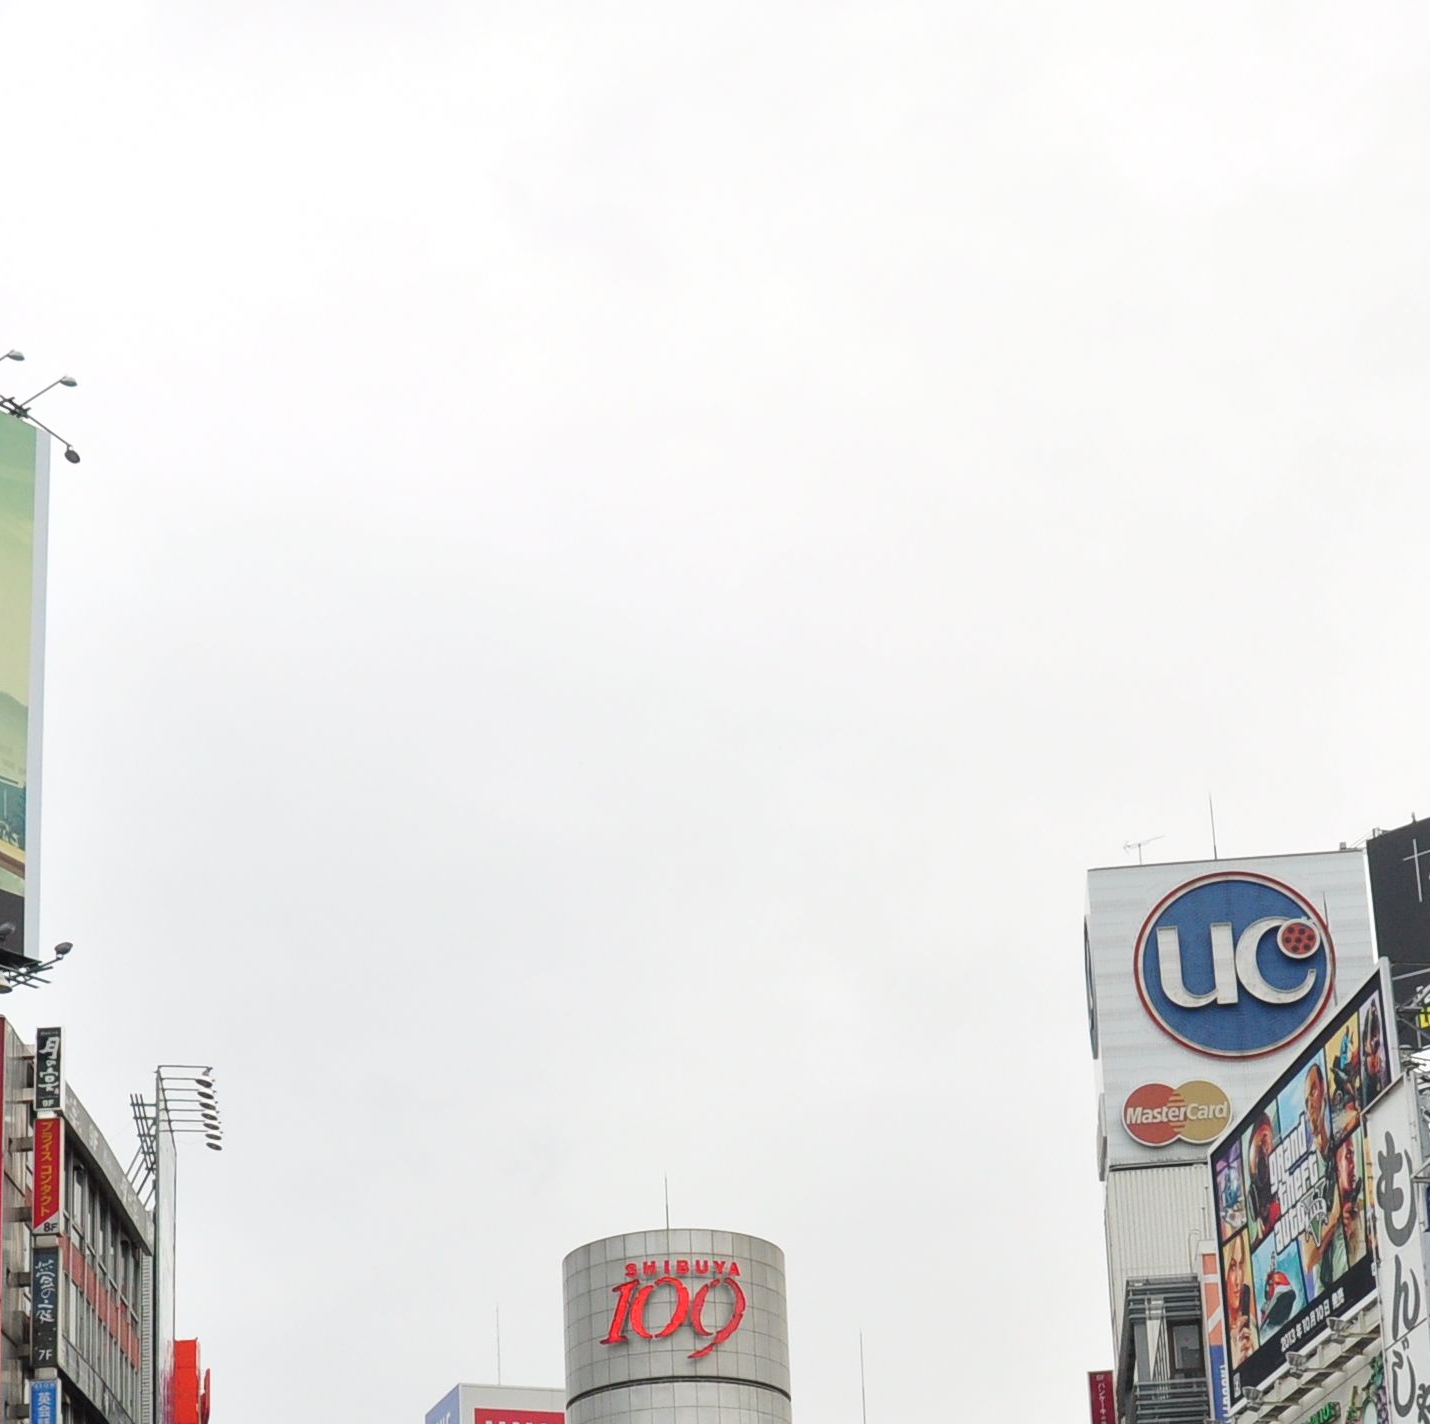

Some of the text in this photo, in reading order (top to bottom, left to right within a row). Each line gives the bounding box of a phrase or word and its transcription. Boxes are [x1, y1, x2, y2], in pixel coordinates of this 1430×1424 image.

[1124, 1098, 1231, 1131] MasterCard
[39, 1121, 54, 1217] プライス コンタクト
[43, 1222, 57, 1233] 8F
[624, 1259, 742, 1278] SHIBUYA
[598, 1276, 748, 1360] 109
[38, 1349, 53, 1361] 7F
